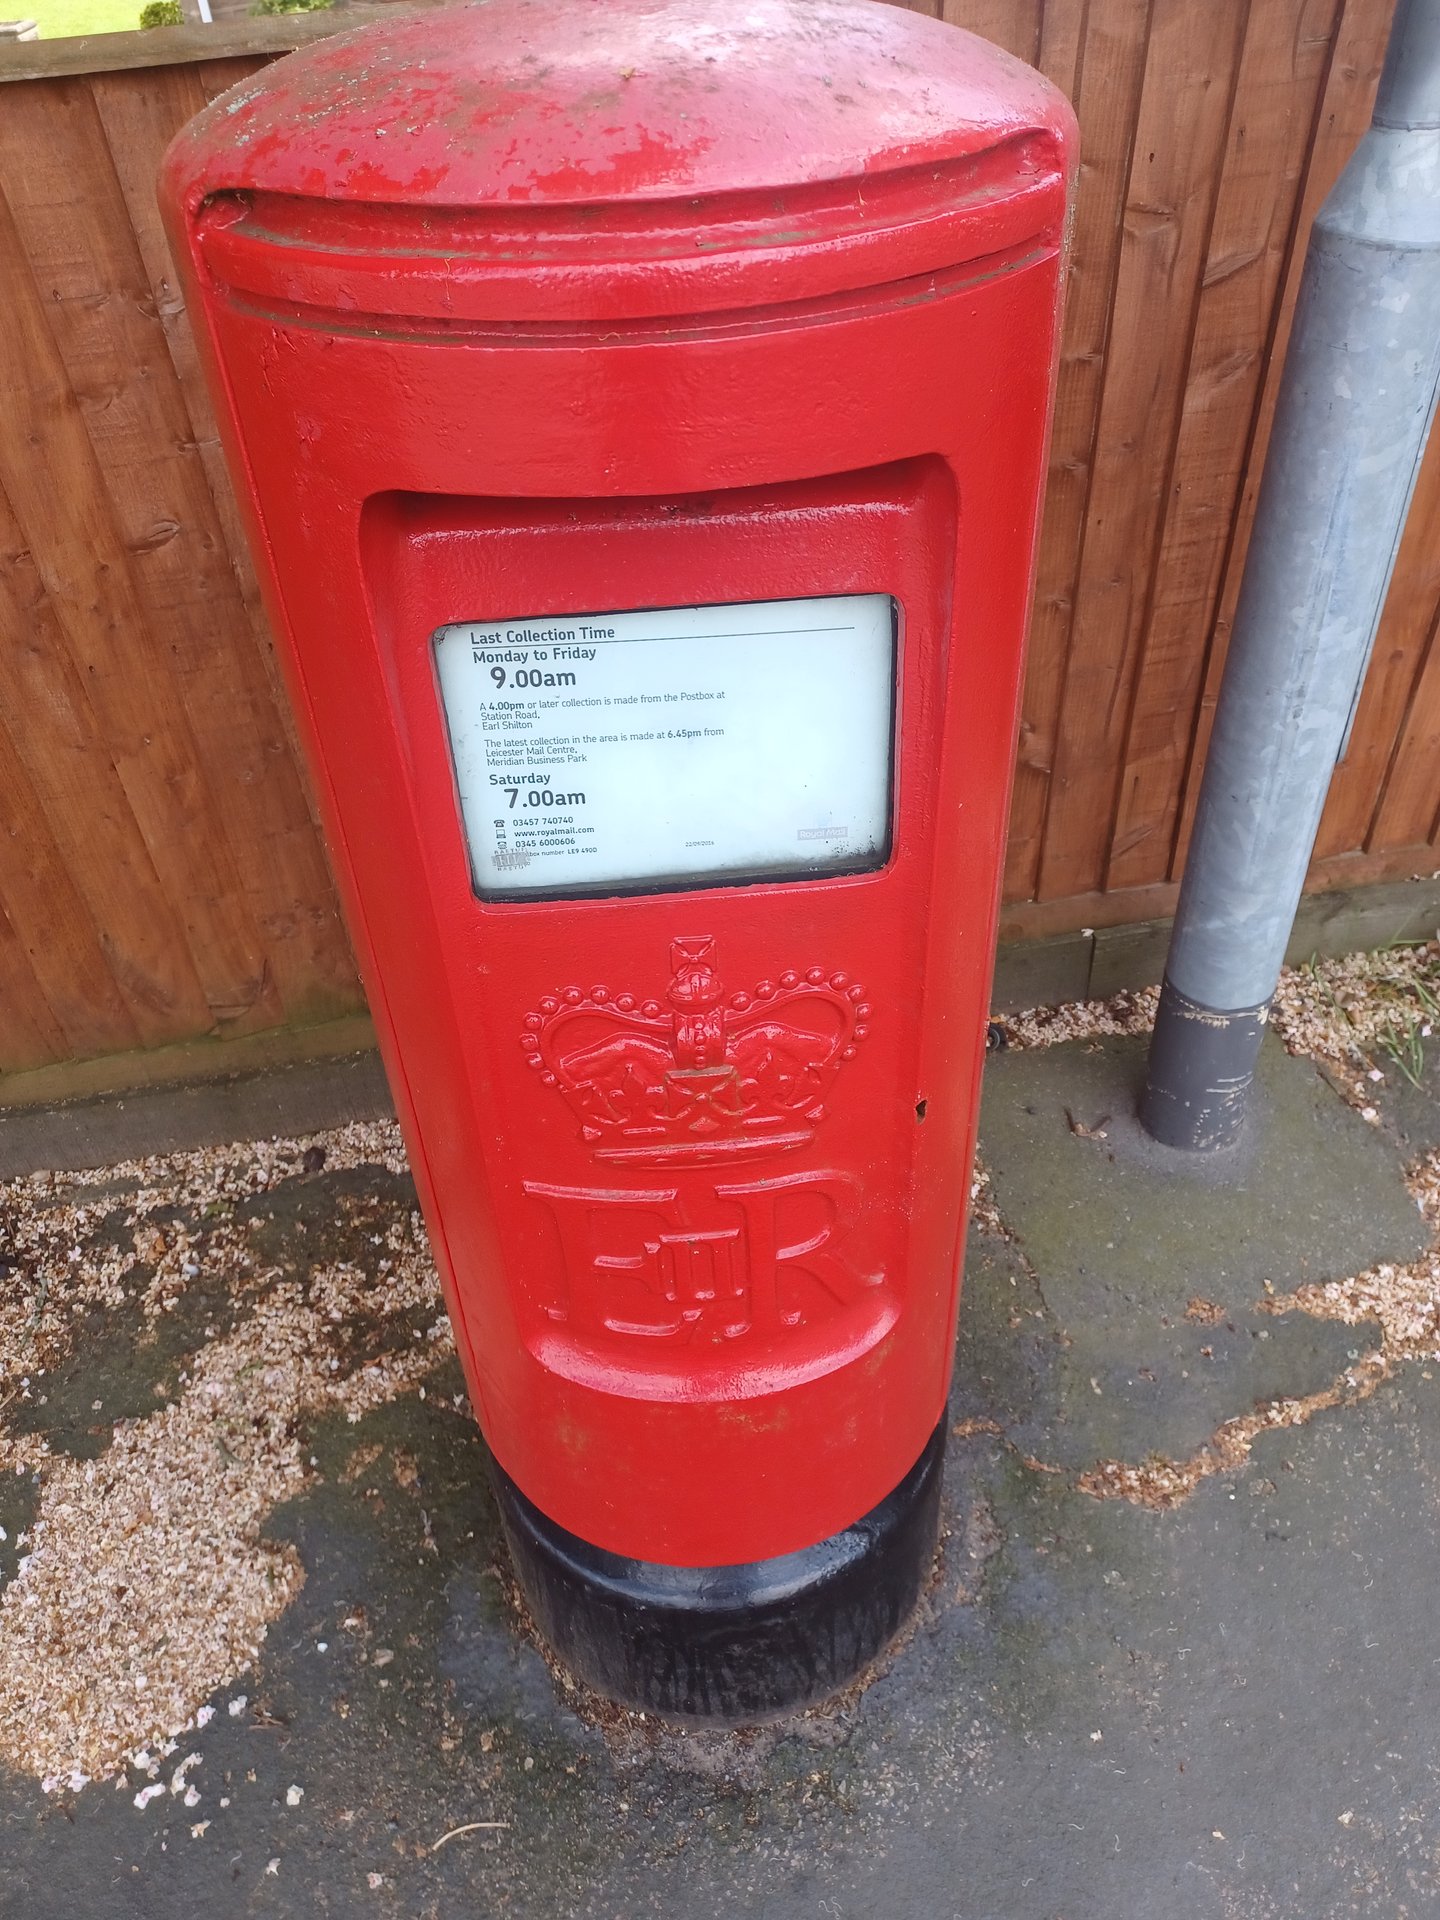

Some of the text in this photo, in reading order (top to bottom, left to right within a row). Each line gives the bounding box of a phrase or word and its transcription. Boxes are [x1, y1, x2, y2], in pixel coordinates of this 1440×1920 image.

[470, 626, 615, 645] Last Collection Time
[473, 647, 596, 665] Monday to Friday
[490, 666, 576, 689] 9.00am
[479, 691, 725, 712] A 4.00pm or later collection is made from the Postbox at
[481, 711, 512, 720] Station
[482, 720, 533, 730] Earl Shilton
[485, 727, 724, 748] The latest collection in the area is made at 6.45pm from
[486, 748, 524, 757] Leicester
[527, 747, 545, 756] Mail
[487, 754, 587, 766] Meridian Business Park
[489, 773, 551, 786] Saturday
[504, 788, 586, 809] 7.00am
[513, 816, 573, 827] 03457 740740
[514, 826, 595, 838] www.royalmail.com
[800, 828, 846, 839] Royal Mail
[515, 838, 576, 848] 0345 6000606
[567, 847, 579, 855] LE9
